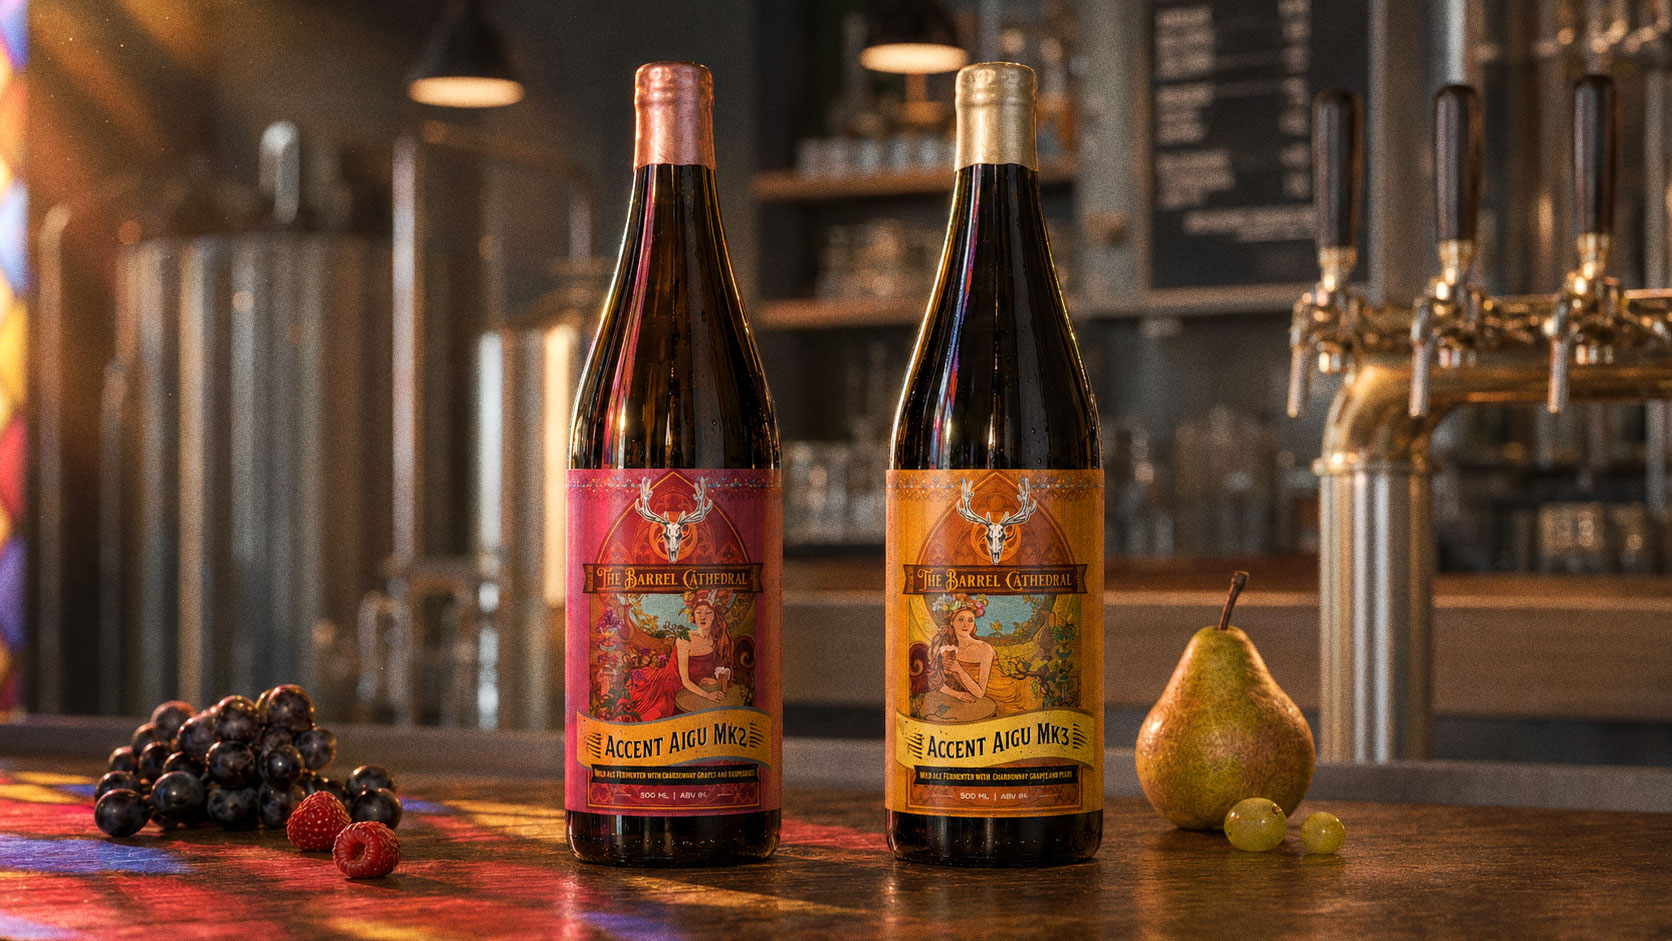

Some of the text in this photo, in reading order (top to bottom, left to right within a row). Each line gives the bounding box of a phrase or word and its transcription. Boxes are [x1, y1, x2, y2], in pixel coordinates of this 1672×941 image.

[597, 567, 748, 590] THE BARREL CATHEDRAL
[917, 569, 1072, 592] THE BARREL CATHEDRAL
[605, 735, 663, 759] ACCENT
[669, 726, 707, 754] AIGU
[927, 735, 986, 759] ACCENT
[992, 726, 1031, 754] AIGU
[960, 792, 976, 800] 500
